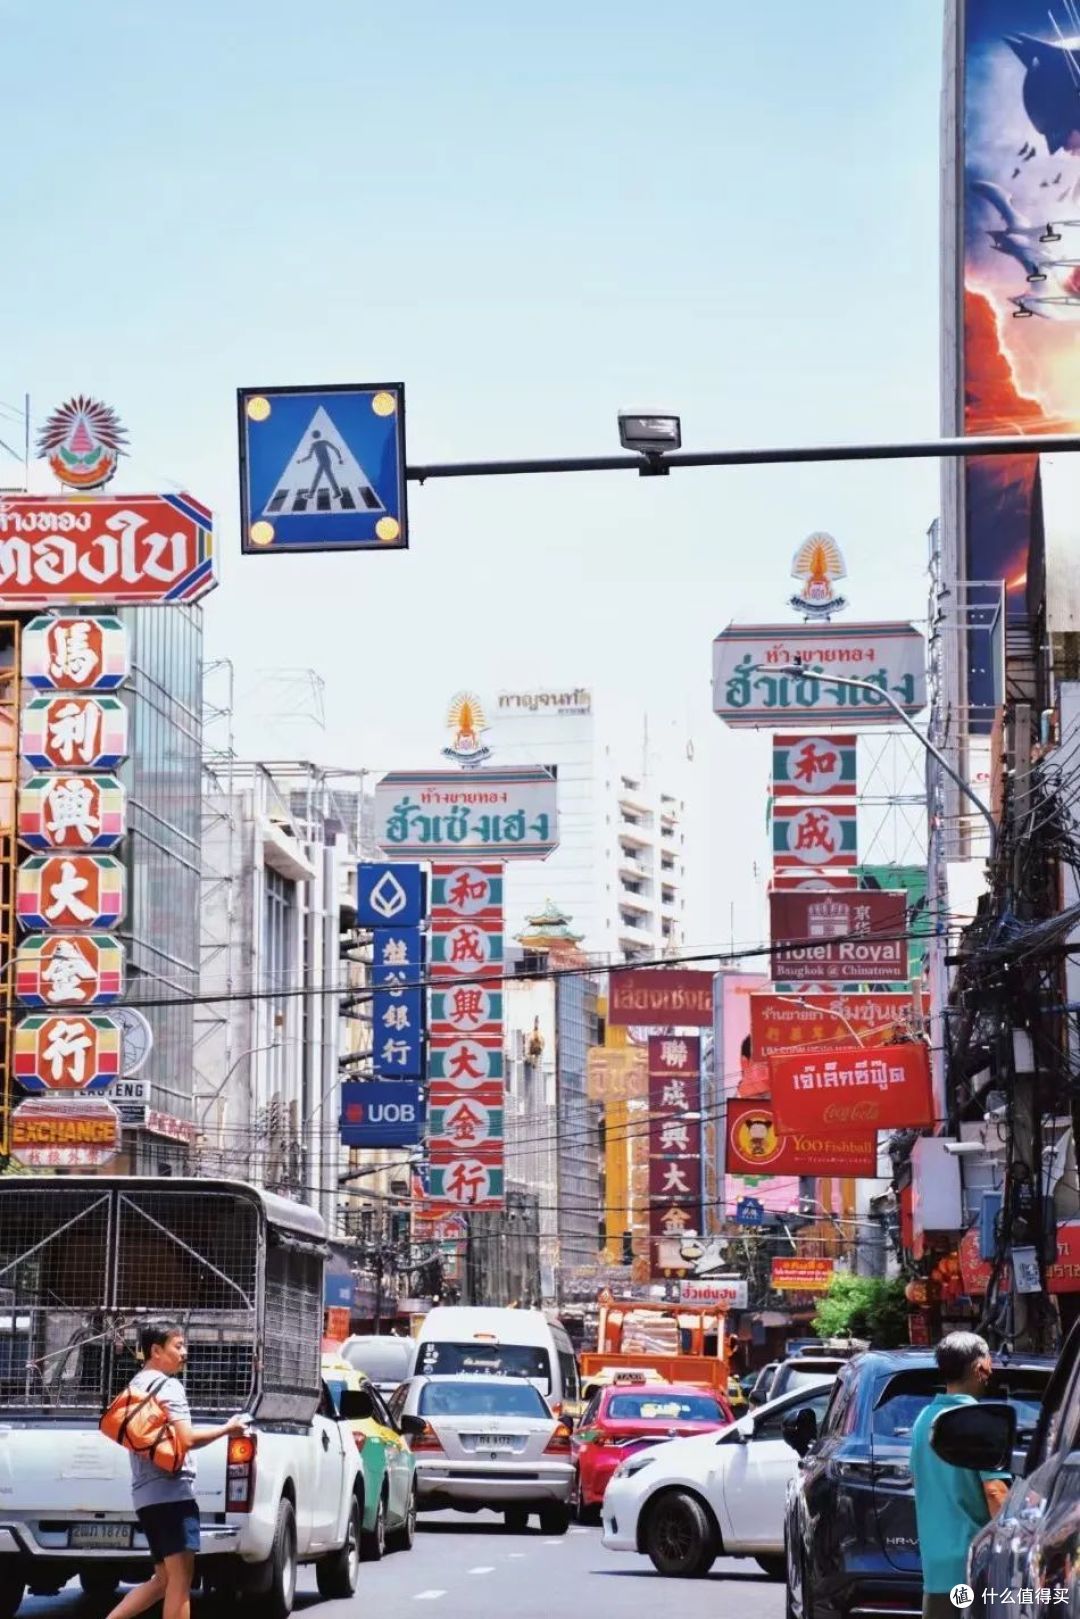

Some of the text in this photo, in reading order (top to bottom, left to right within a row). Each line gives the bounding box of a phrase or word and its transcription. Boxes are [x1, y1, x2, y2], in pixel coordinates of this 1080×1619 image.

[386, 796, 550, 843] ฮั่วเซ่งเฮง
[776, 942, 902, 962] Hotel Royal
[776, 966, 824, 977] Bangkok
[841, 965, 903, 976] Chinatown
[368, 1104, 415, 1122] UOB
[13, 1121, 117, 1144] EXCHANGE
